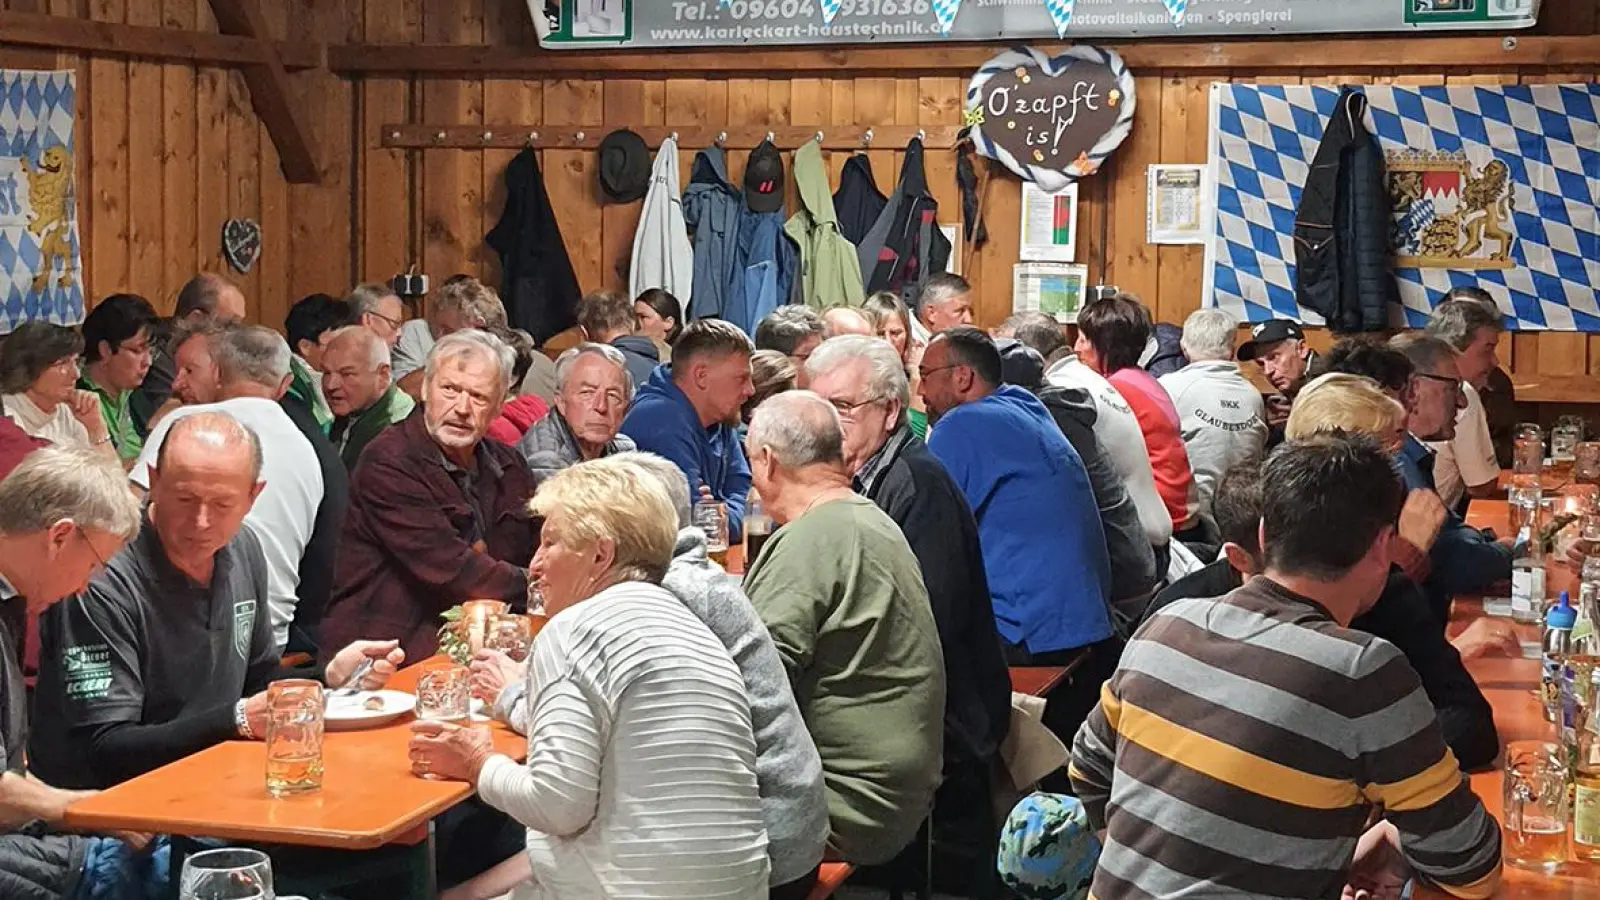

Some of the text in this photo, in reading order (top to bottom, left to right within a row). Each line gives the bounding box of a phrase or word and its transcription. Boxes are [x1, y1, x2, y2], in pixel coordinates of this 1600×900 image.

[672, 0, 930, 20] Tel.: 09604 931636
[1217, 8, 1292, 24] Spenglerei
